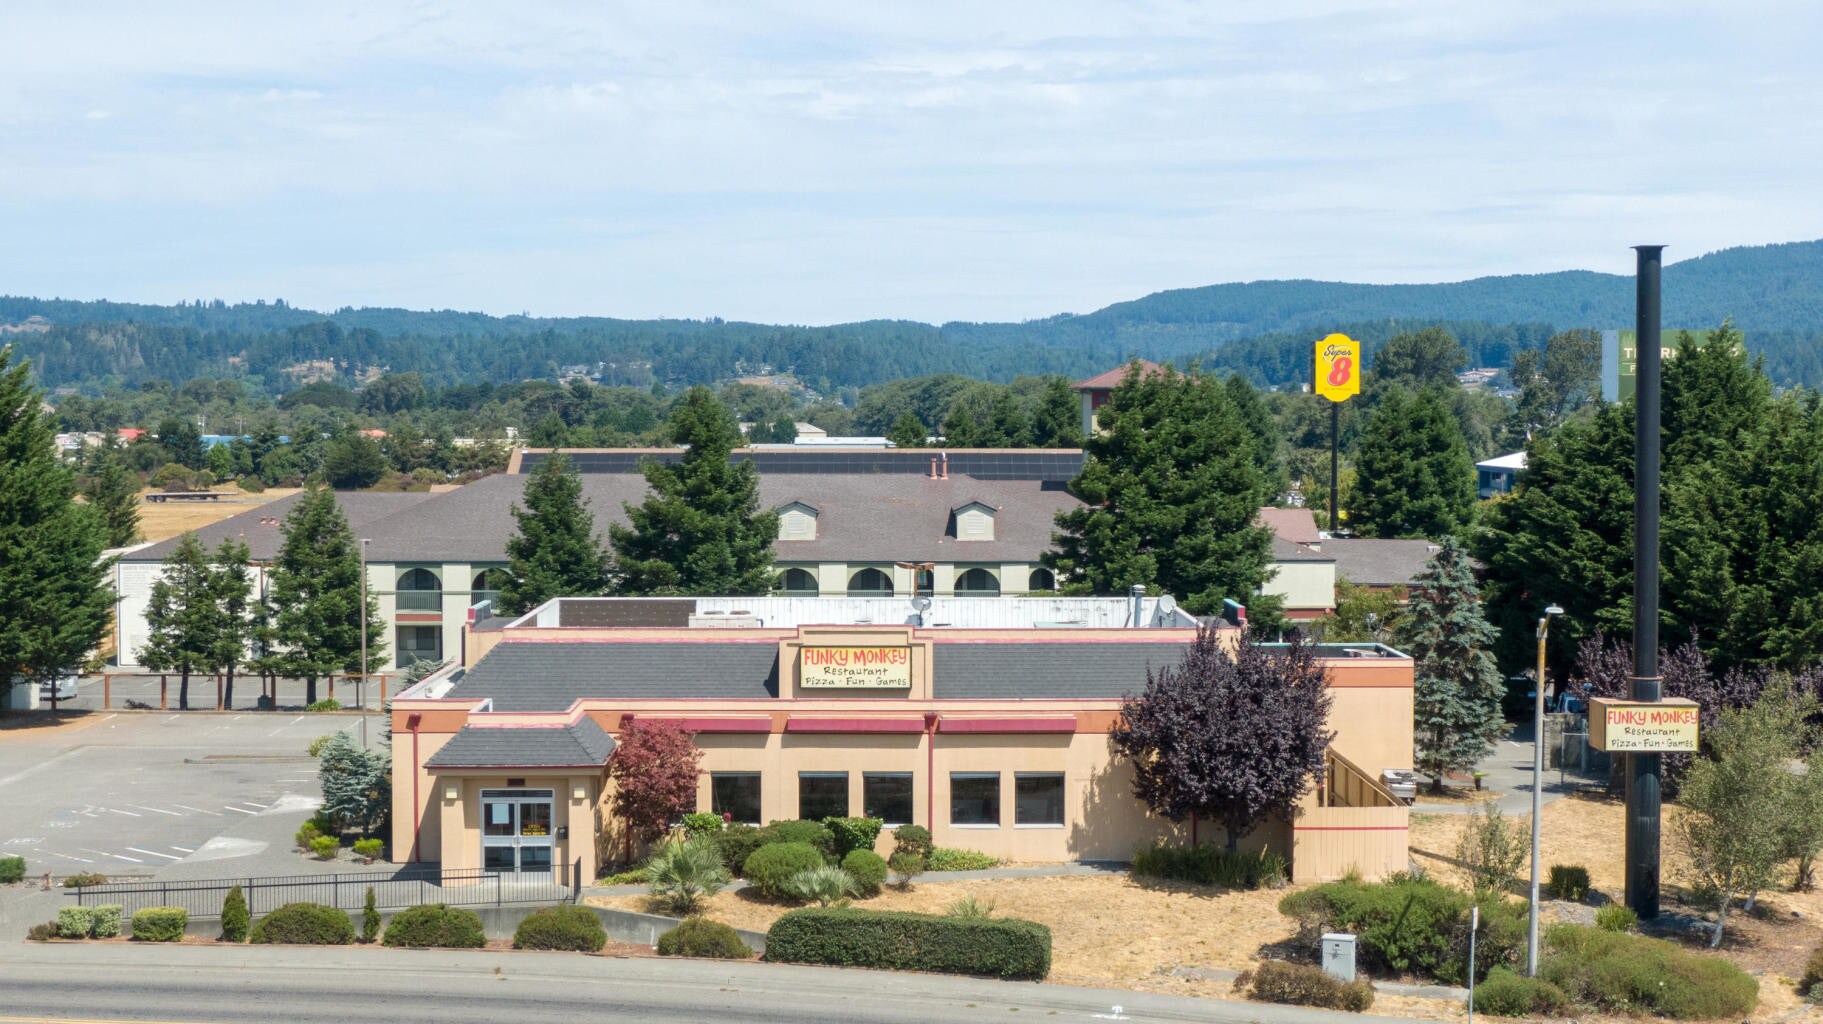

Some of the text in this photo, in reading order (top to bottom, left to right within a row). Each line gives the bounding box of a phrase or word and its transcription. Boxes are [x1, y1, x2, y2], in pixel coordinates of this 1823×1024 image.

[1324, 344, 1352, 361] Super
[1327, 356, 1352, 386] 8
[804, 648, 907, 666] FUNKY MONKEY
[823, 666, 889, 675] Restaurant
[805, 676, 907, 686] Pizza Fun Games
[1607, 710, 1699, 725] FUNKY MONKEY
[1624, 727, 1680, 736] Restaurant
[1611, 738, 1694, 748] Pizza Fun Games
